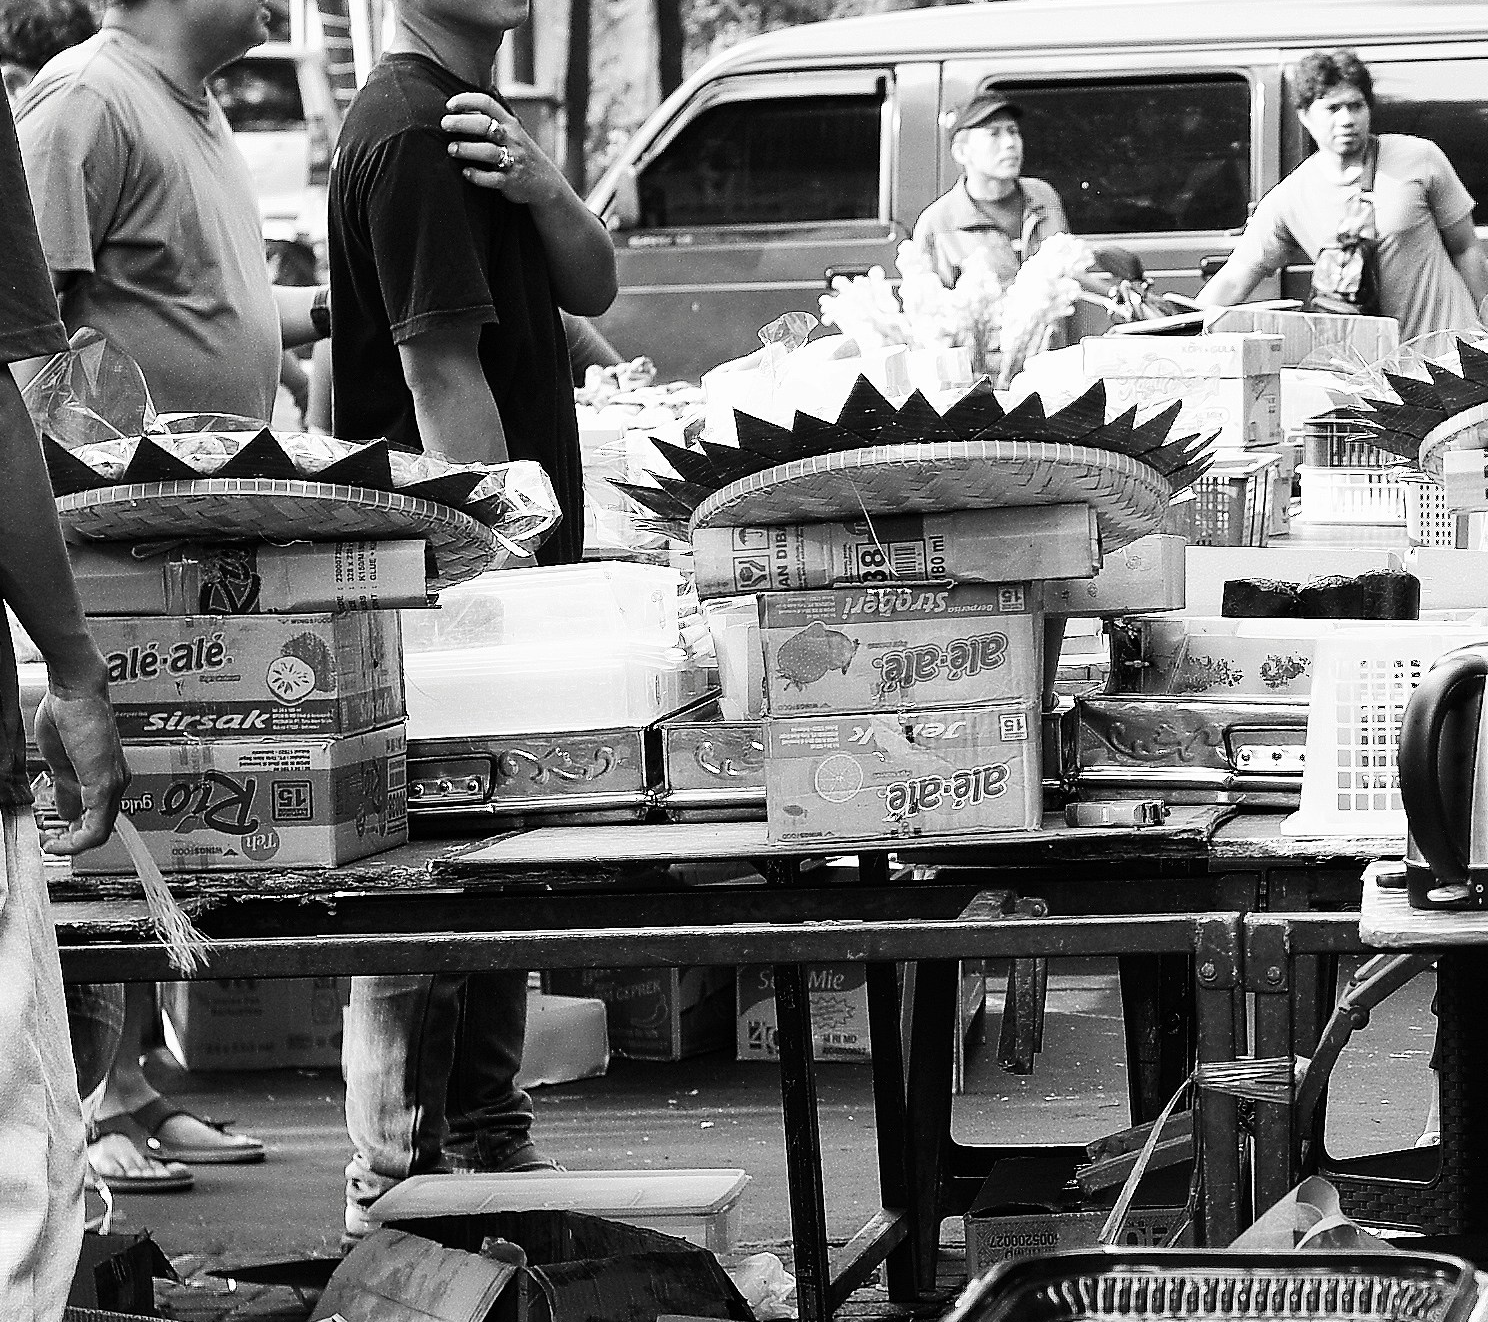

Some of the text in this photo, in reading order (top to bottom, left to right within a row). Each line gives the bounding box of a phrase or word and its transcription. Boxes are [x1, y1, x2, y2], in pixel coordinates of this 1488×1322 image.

[840, 589, 950, 621] Stroberi
[143, 708, 269, 732] sirsak
[1003, 718, 1023, 731] 15
[162, 769, 259, 836] Rio
[279, 786, 308, 809] 15
[245, 832, 277, 852] Teh
